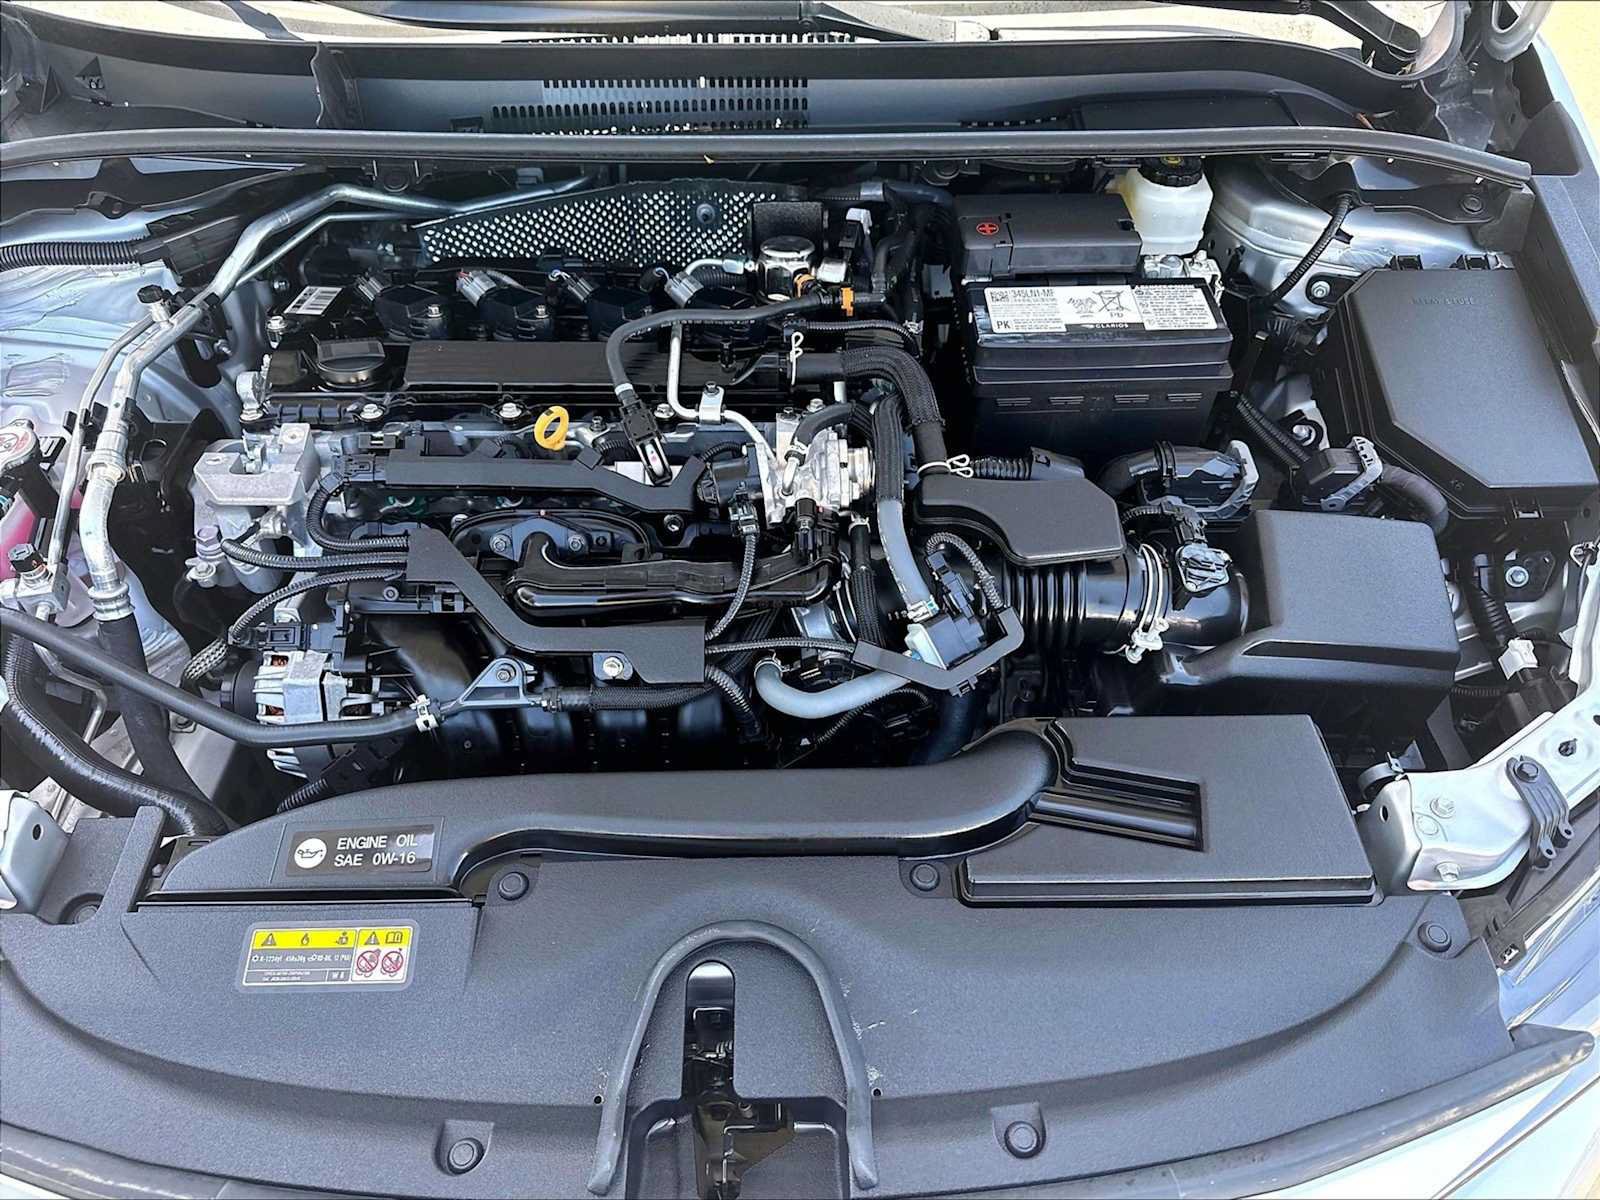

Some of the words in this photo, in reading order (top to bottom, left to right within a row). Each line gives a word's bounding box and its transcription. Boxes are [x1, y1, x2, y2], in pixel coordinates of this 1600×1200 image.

[996, 320, 1011, 330] PK
[336, 835, 388, 850] ENGINE
[396, 833, 418, 847] OIL
[334, 853, 363, 867] SAE
[372, 851, 416, 866] 0W-16
